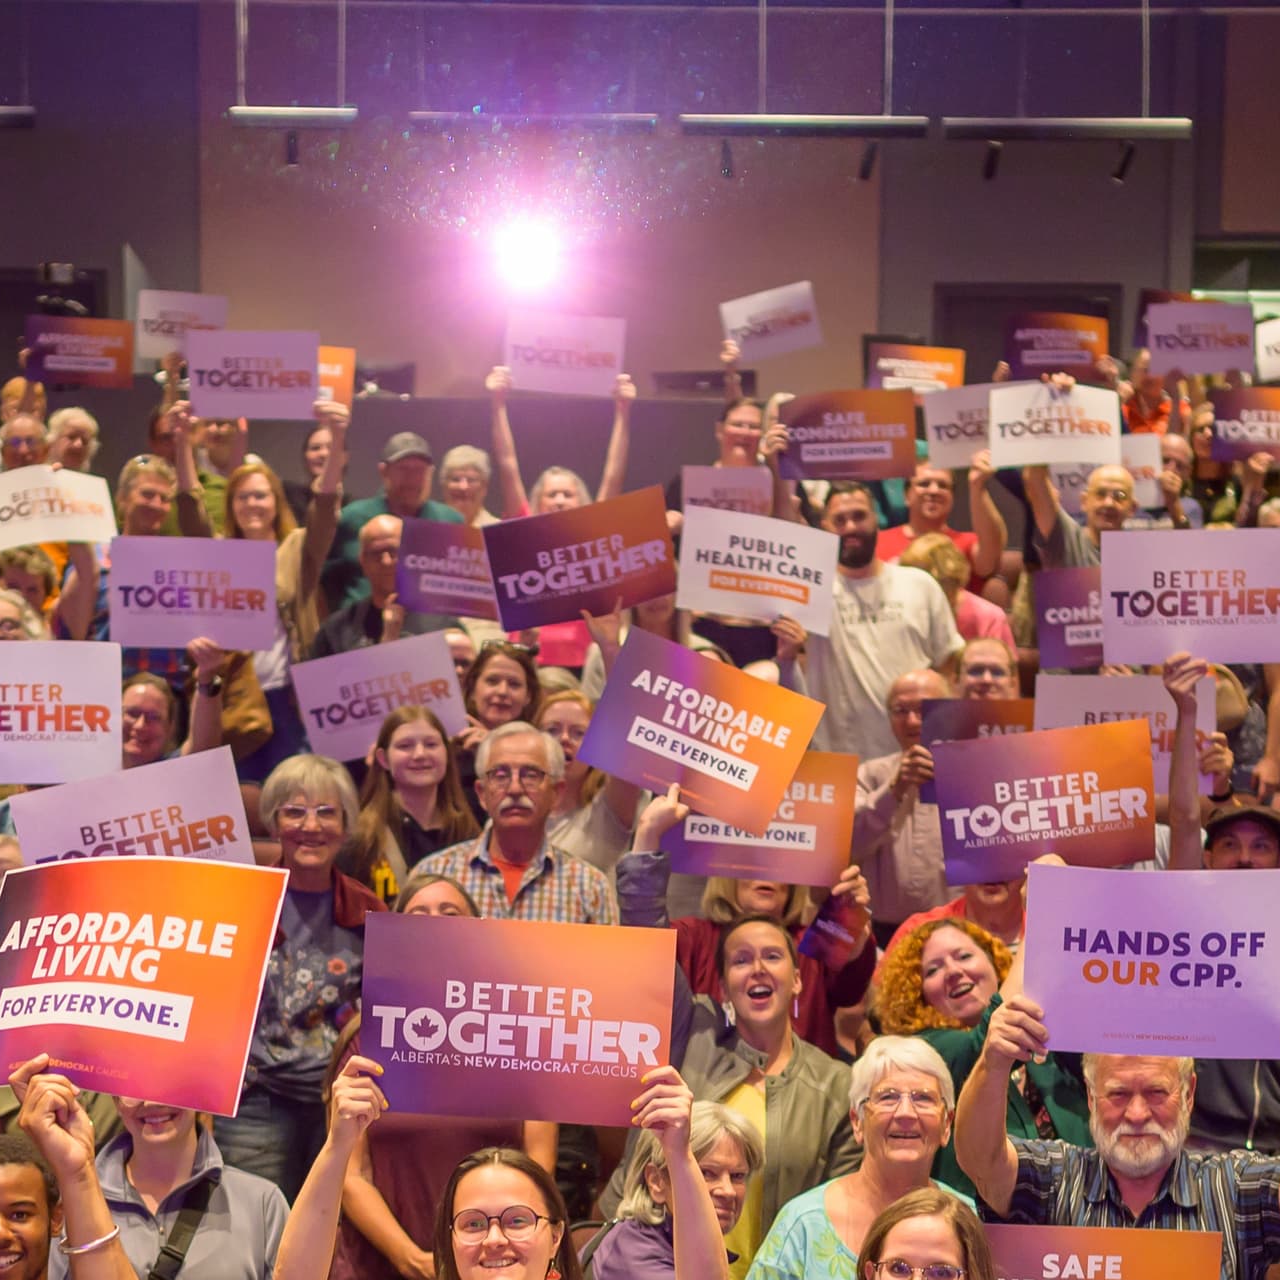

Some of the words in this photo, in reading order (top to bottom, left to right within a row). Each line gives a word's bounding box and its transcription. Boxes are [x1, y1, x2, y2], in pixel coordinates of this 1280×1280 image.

[194, 369, 311, 389] TOGETHER
[223, 356, 282, 369] BETTER
[998, 417, 1112, 438] TOGETHER
[537, 533, 624, 569] BETTER
[729, 533, 797, 561] PUBLIC
[154, 569, 232, 585] BETTER
[498, 539, 667, 600] TOGETHER
[696, 548, 771, 574] HEALTH
[776, 562, 824, 586] CARE
[1153, 570, 1246, 589] BETTER
[118, 584, 267, 611] TOGETHER
[338, 670, 414, 700] BETTER
[309, 678, 452, 729] TOGETHER
[631, 670, 792, 750] AFFORDABLE
[662, 704, 749, 755] LIVING
[634, 725, 667, 748] FOR
[670, 738, 749, 783] EVERYONE.
[993, 771, 1099, 804] BETTER
[80, 805, 184, 847] BETTER
[690, 822, 719, 836] FOR
[945, 786, 1148, 840] TOGETHER
[964, 834, 1015, 848] ALBERTA'S
[1016, 830, 1040, 842] NEW
[1042, 824, 1095, 840] DEMOCRAT
[0, 911, 238, 958] AFFORDABLE
[1063, 926, 1191, 957] HANDS
[1200, 931, 1266, 957] OFF
[32, 945, 162, 983] LIVING
[1082, 958, 1161, 987] OUR
[1170, 962, 1243, 989] CPP.
[0, 996, 36, 1019] FOR
[39, 993, 180, 1029] EVERYONE.
[445, 980, 594, 1018] BETTER
[372, 1004, 661, 1067] TOGETHER
[390, 1050, 462, 1068] ALBERTA'S
[464, 1055, 498, 1069] NEW
[500, 1057, 579, 1075] DEMOCRAT
[581, 1063, 638, 1079] CAUCUS
[1042, 1253, 1122, 1280] SAFE
